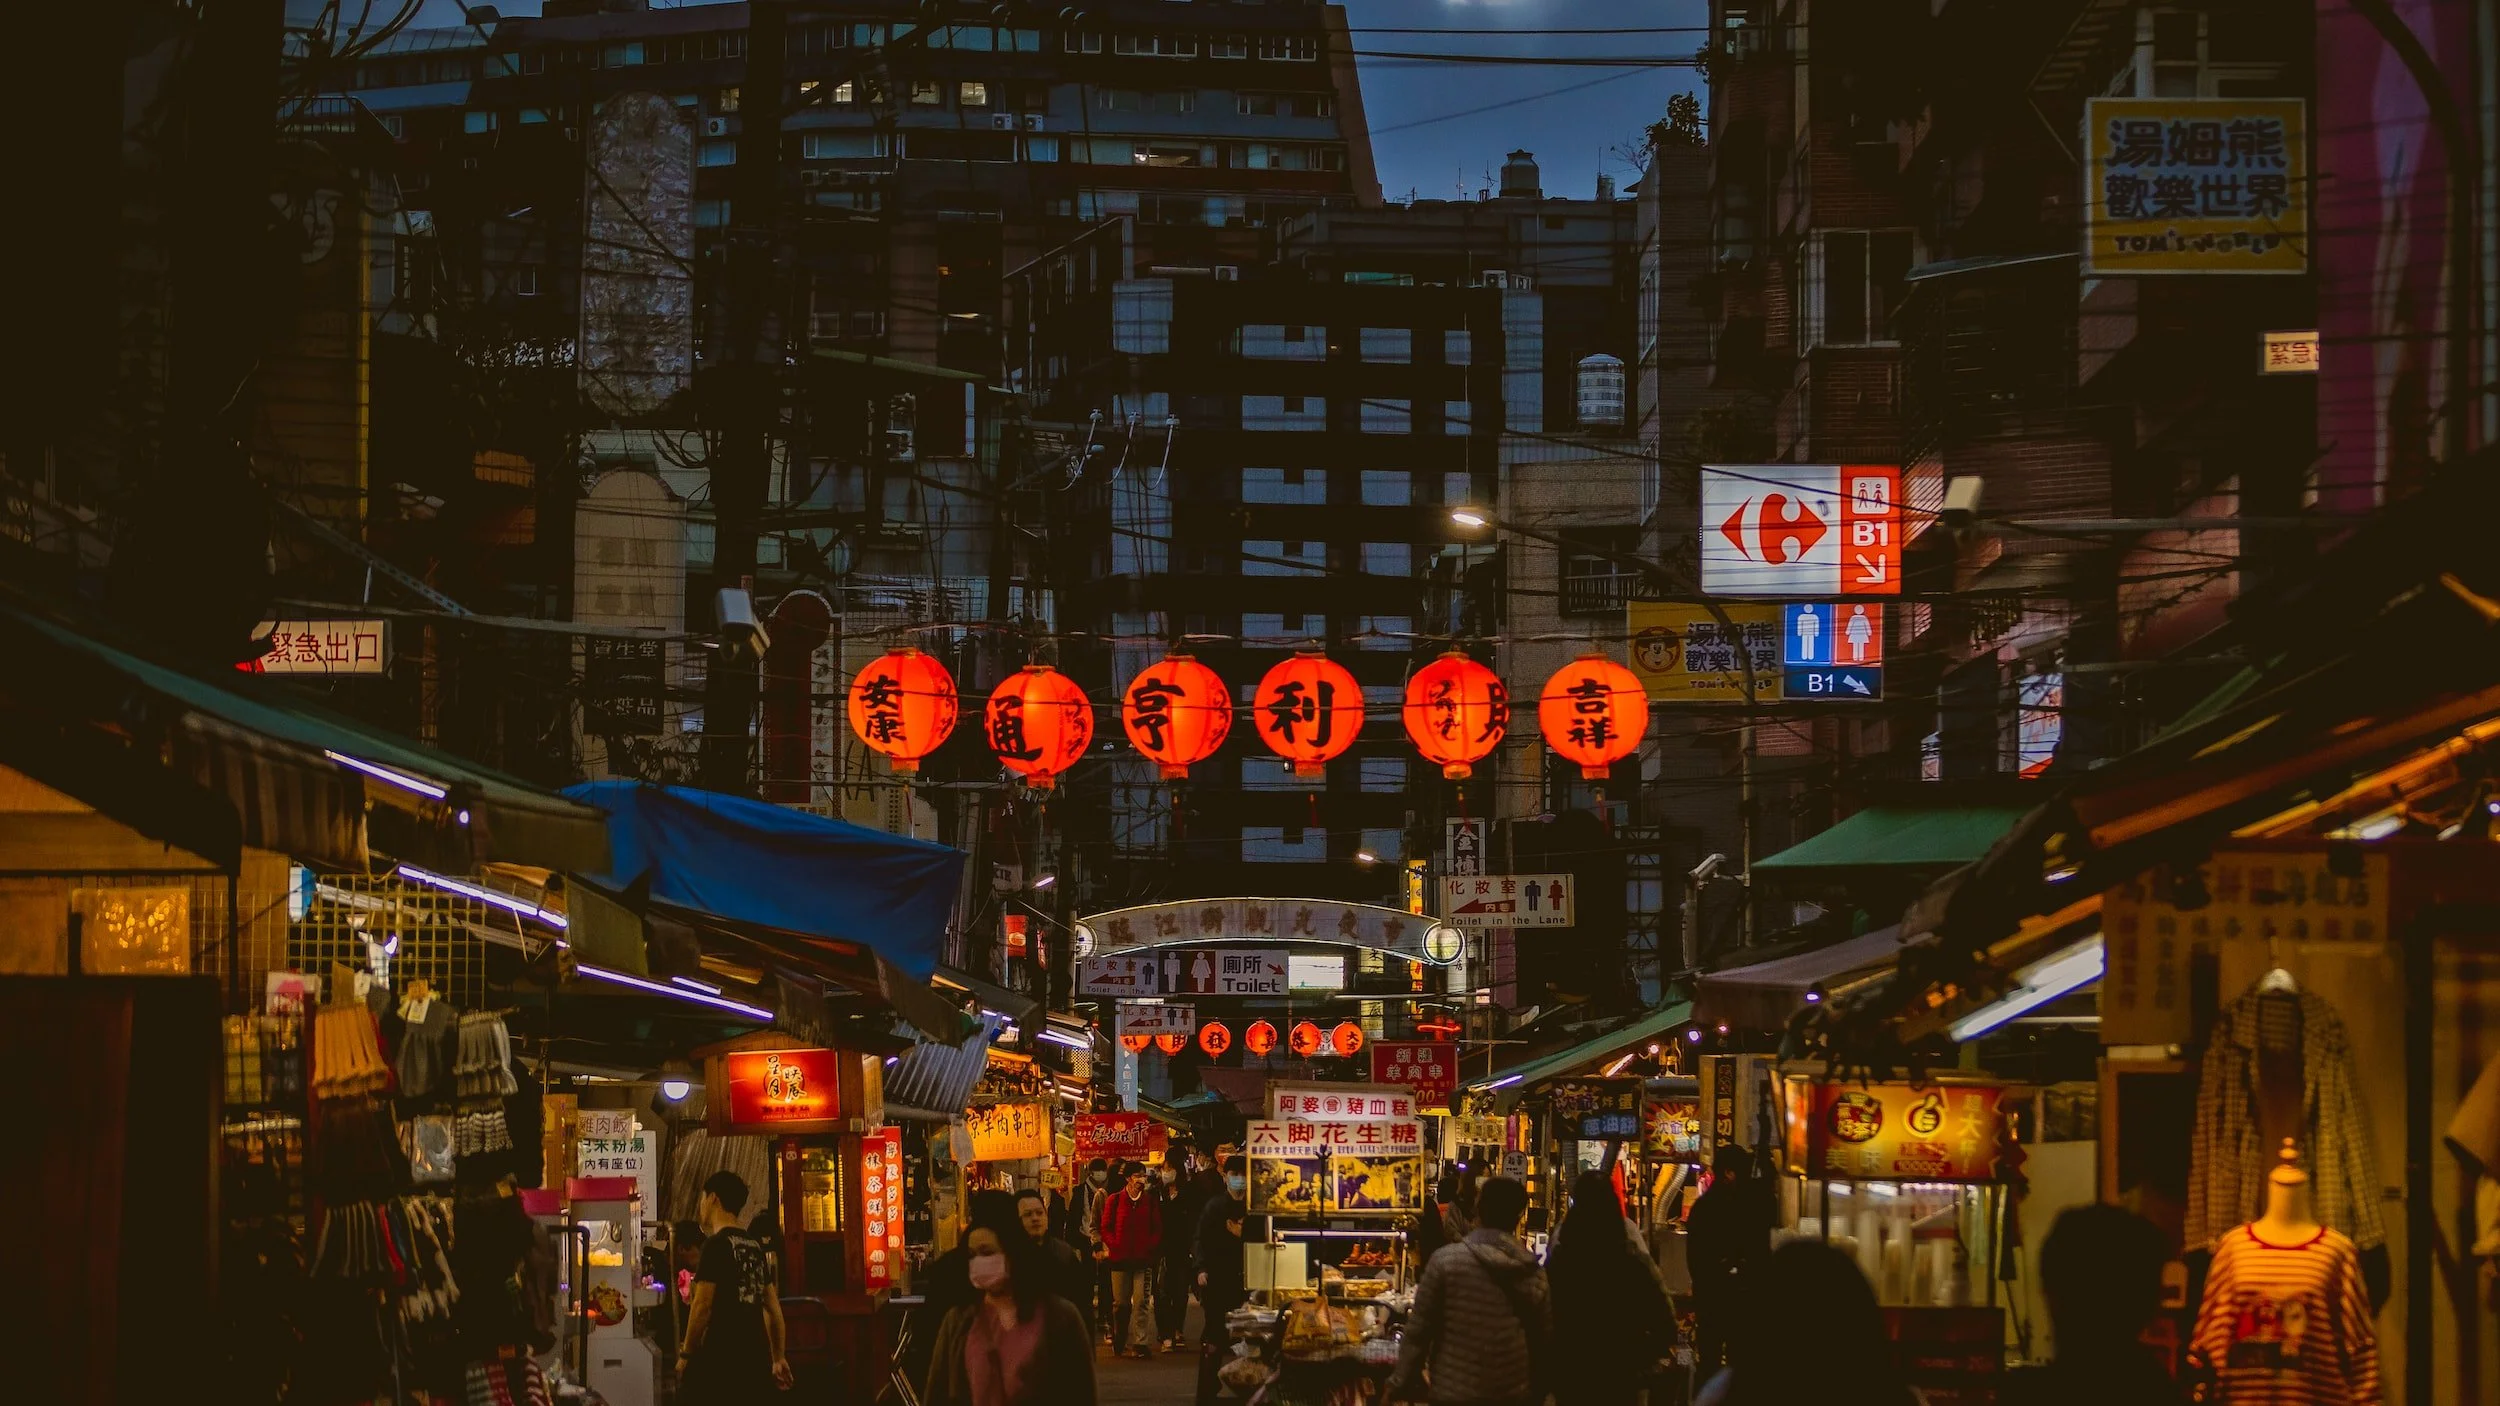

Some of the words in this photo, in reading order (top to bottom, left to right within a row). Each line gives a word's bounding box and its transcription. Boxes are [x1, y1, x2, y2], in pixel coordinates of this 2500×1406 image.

[2104, 119, 2286, 168] 湯姆熊
[2104, 174, 2289, 218] 歡樂世界
[2270, 342, 2320, 365] 緊急
[1852, 520, 1889, 547] B1
[266, 632, 378, 664] 緊急出口
[1807, 673, 1834, 693] B1
[858, 674, 908, 744] 安康
[1267, 679, 1336, 748] 利
[1566, 677, 1619, 750] 吉祥
[985, 694, 1043, 762] 通
[1450, 917, 1481, 925] Toilet
[1492, 917, 1503, 925] in
[1512, 917, 1530, 925] the
[1539, 916, 1565, 925] Lane
[1222, 978, 1281, 993] Toilet
[1207, 1030, 1227, 1050] 發
[578, 1115, 629, 1135] 雞肉飯
